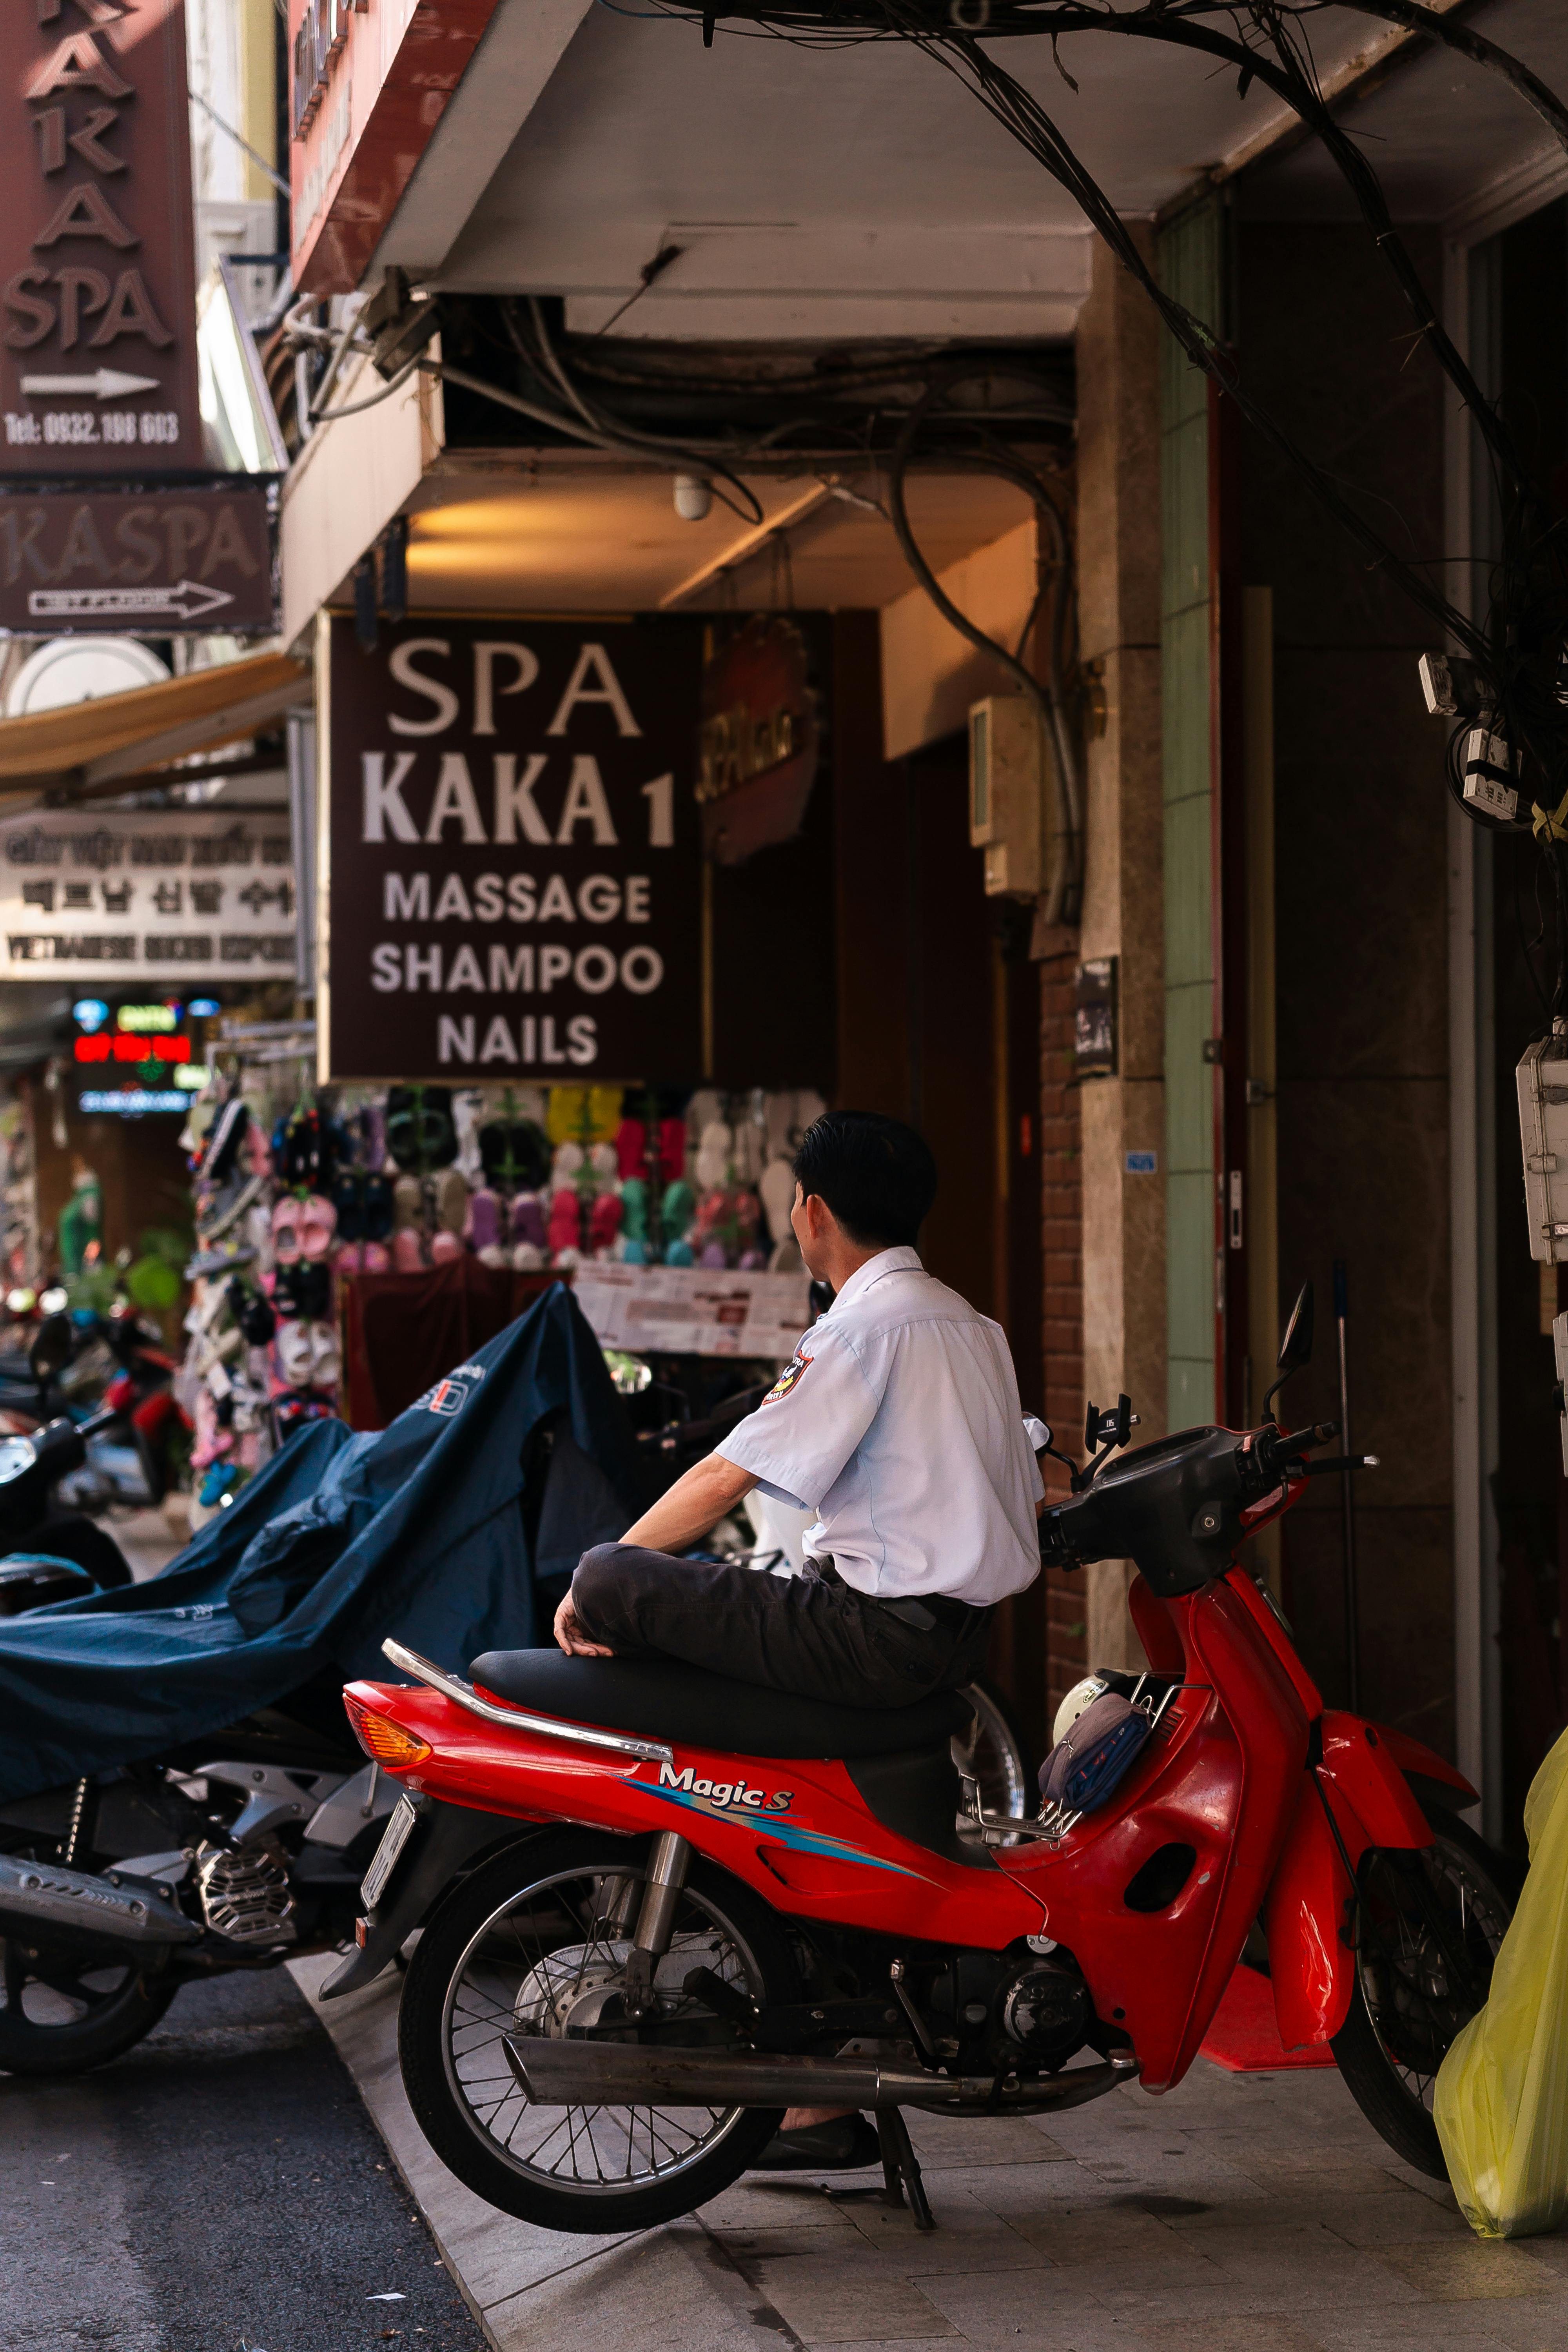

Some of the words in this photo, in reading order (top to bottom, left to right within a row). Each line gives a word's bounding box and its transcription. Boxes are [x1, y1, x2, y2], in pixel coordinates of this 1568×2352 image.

[2, 265, 175, 347] SPA
[387, 638, 643, 737] SPA
[361, 751, 619, 845] KAKA
[641, 772, 674, 847] 1
[384, 872, 651, 923] MASSAGE
[371, 942, 664, 994] SHAMPOO
[438, 1015, 598, 1066] NAILS
[659, 1762, 766, 1807] Magic
